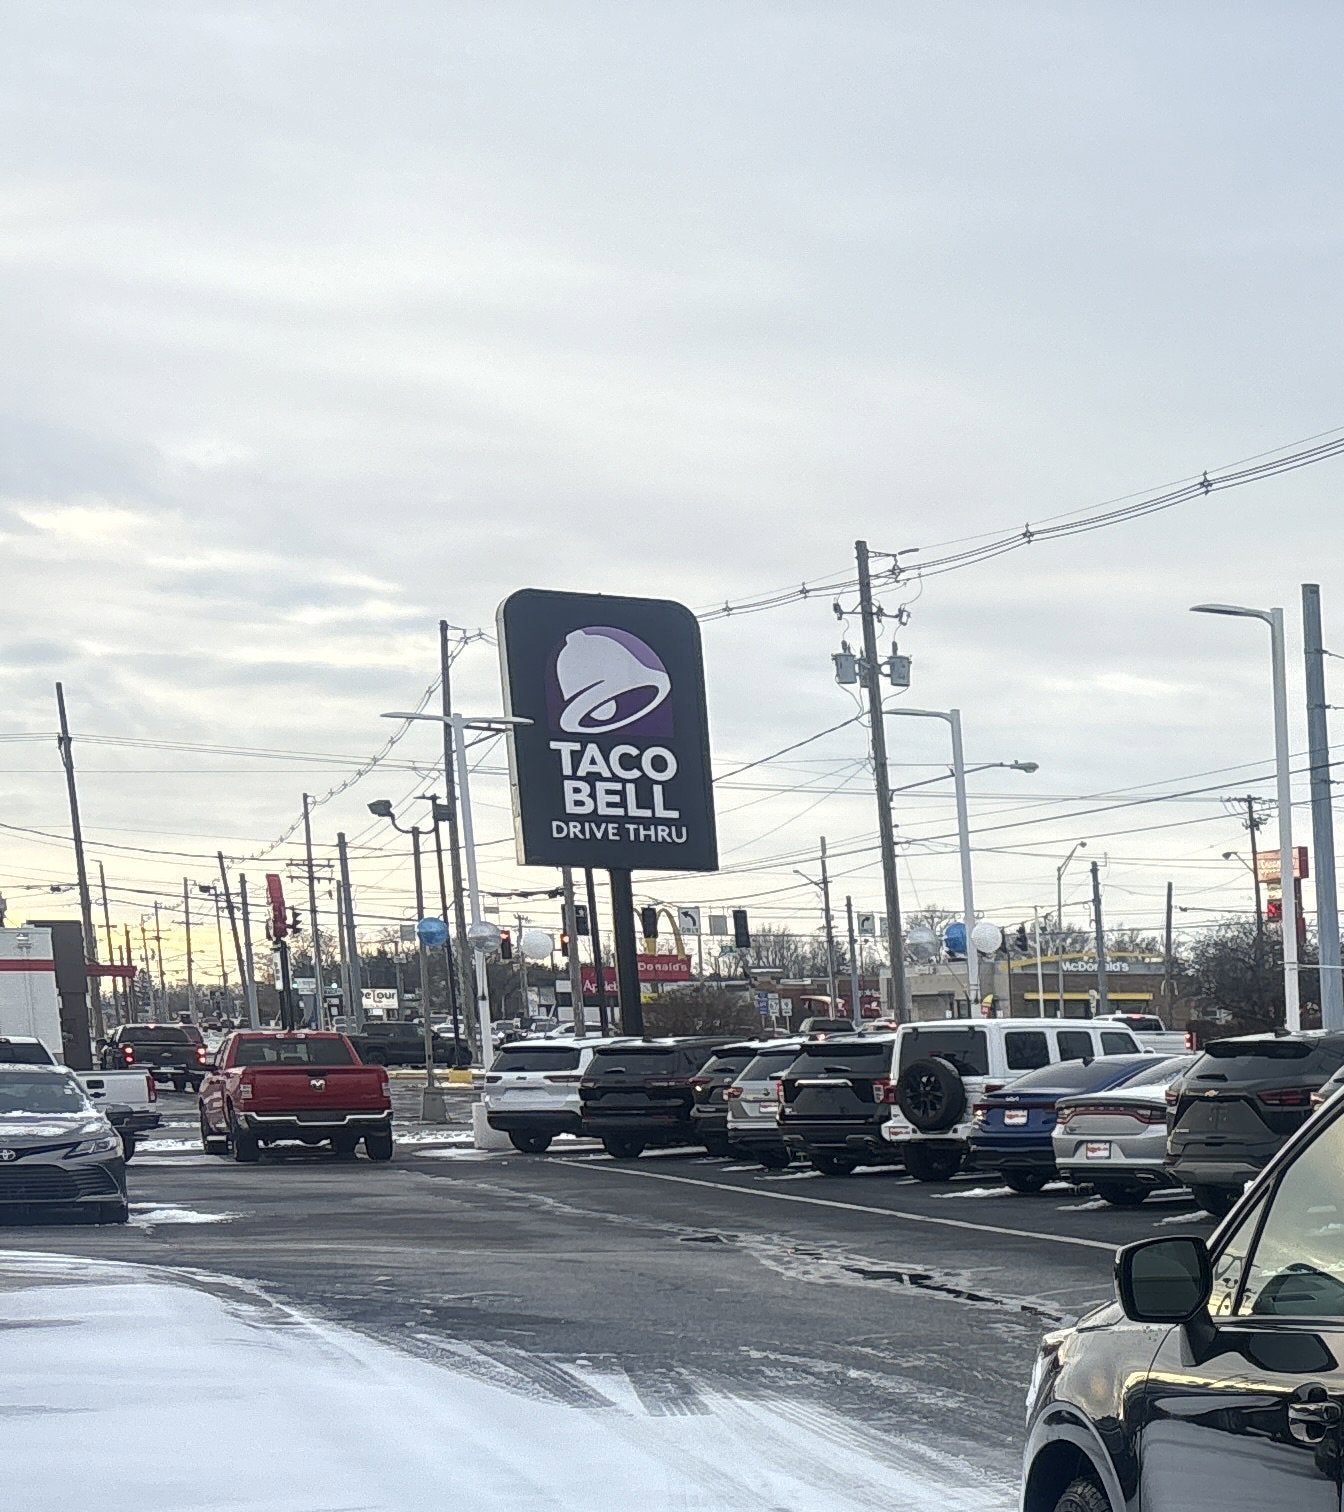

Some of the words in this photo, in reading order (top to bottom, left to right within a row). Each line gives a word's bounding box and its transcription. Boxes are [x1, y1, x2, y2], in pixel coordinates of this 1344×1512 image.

[549, 741, 678, 782] TACO
[563, 779, 680, 819] BELL
[551, 820, 621, 841] DRIVE
[624, 823, 688, 844] THRU
